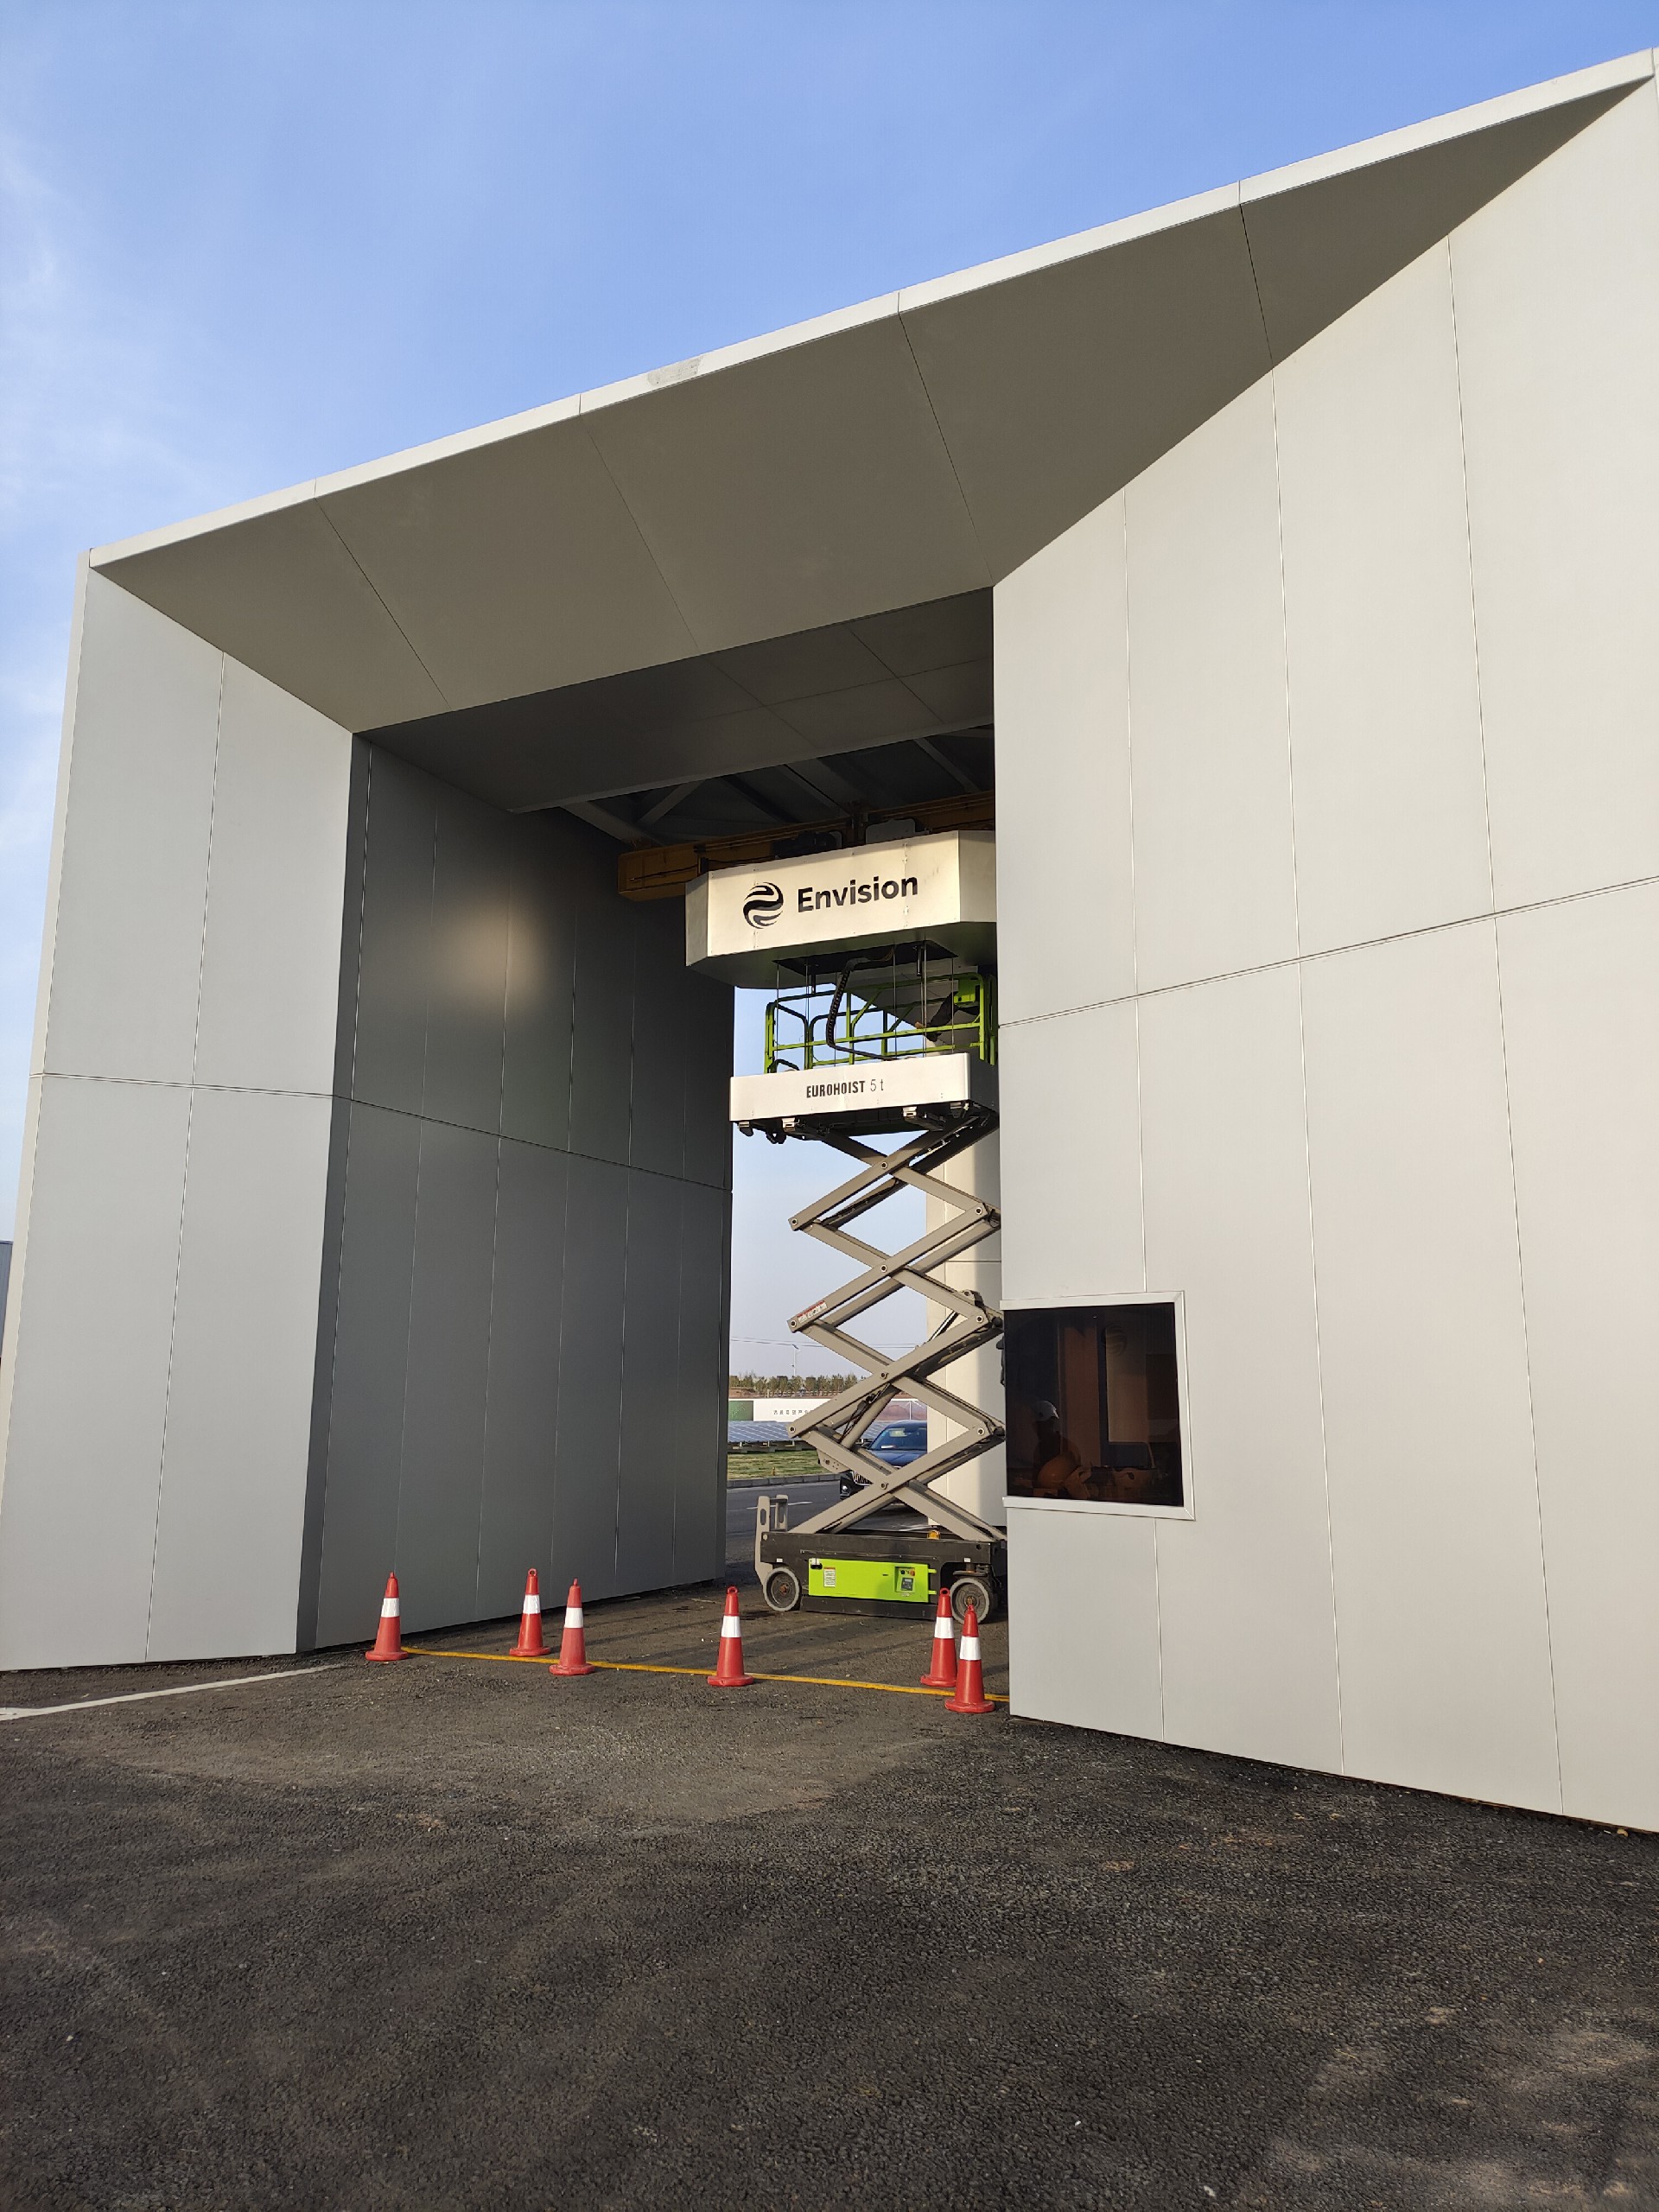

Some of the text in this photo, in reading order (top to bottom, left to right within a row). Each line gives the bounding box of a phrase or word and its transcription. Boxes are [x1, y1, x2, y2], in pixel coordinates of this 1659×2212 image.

[798, 875, 918, 913] Envision
[806, 1078, 884, 1098] EUROHOIST 5 t
